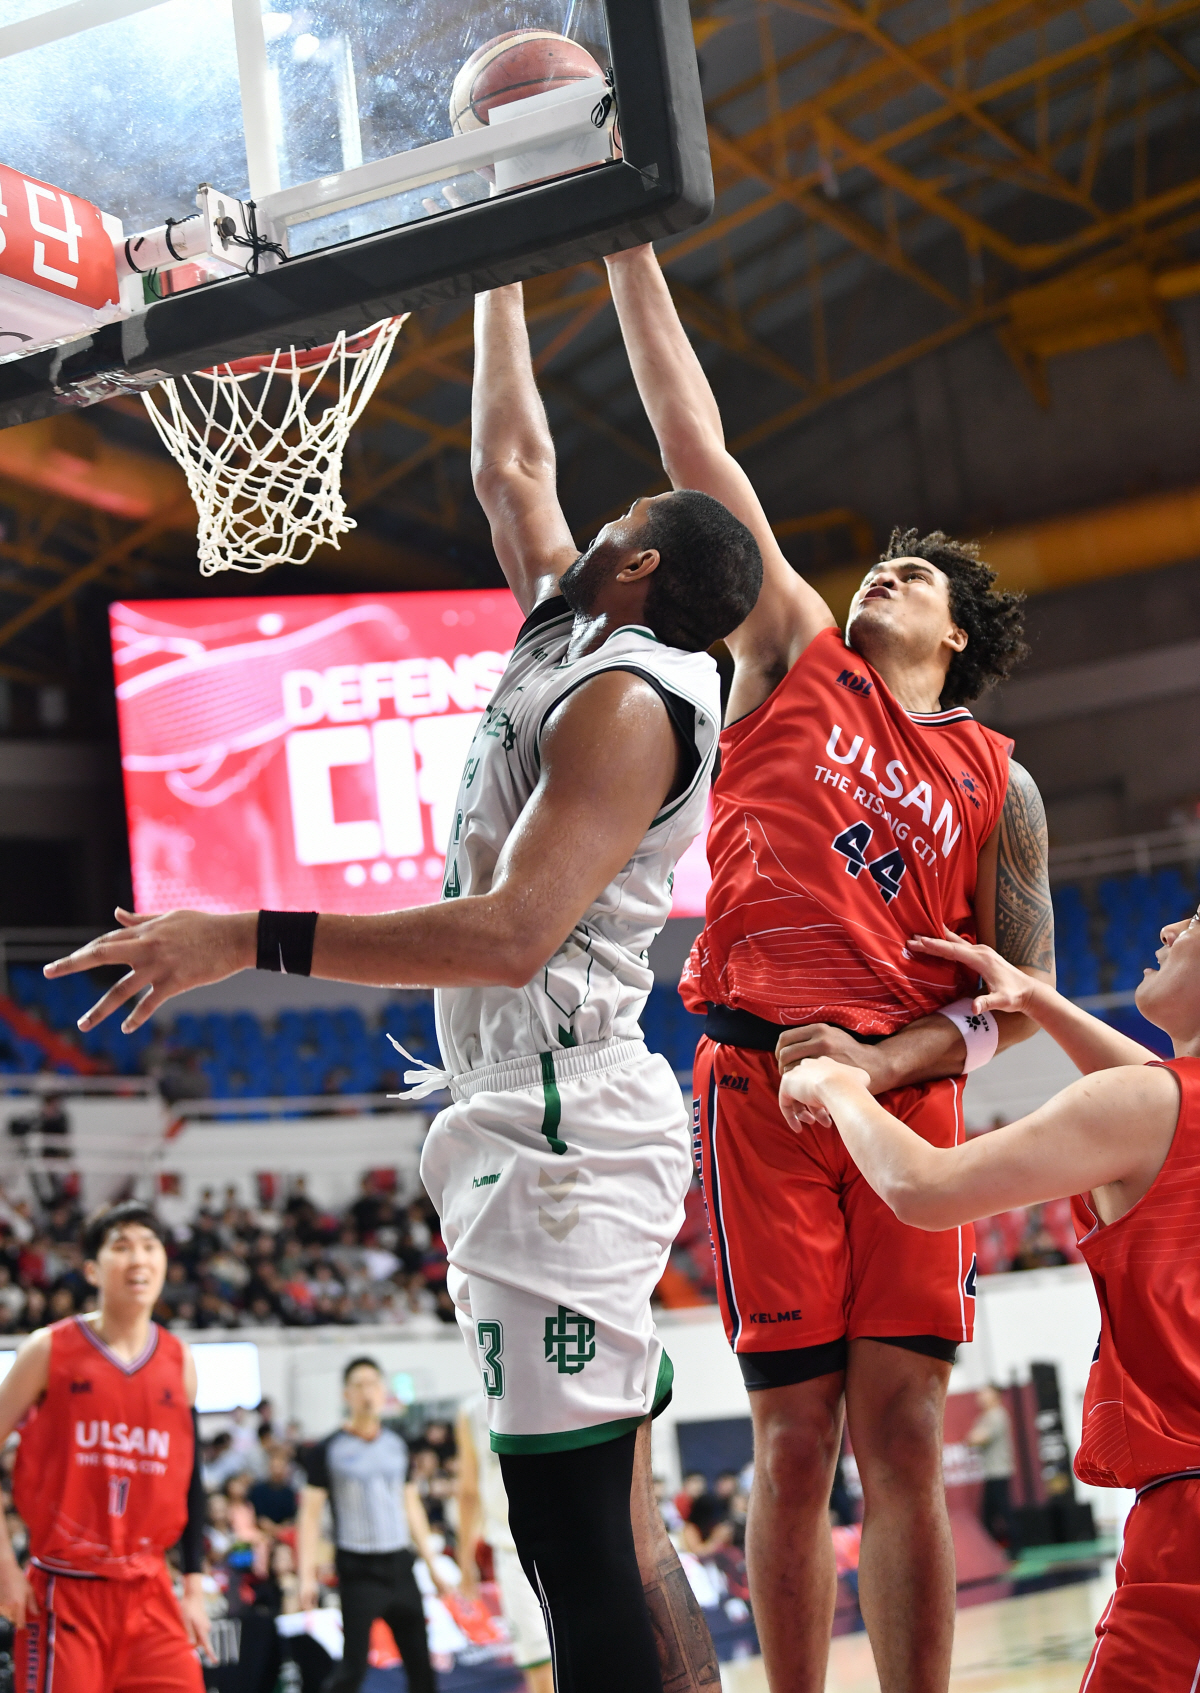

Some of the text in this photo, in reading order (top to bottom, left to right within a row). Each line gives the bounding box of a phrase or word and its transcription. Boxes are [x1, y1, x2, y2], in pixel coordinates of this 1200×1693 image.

[0, 179, 82, 290] 단
[281, 651, 513, 724] DEFENS
[814, 765, 851, 793] THE
[912, 836, 938, 877] CIT
[825, 724, 962, 859] ULSAN
[831, 820, 907, 906] 44
[750, 1310, 802, 1324] KELME
[477, 1319, 505, 1400] 3
[75, 1420, 170, 1459] ULSAN
